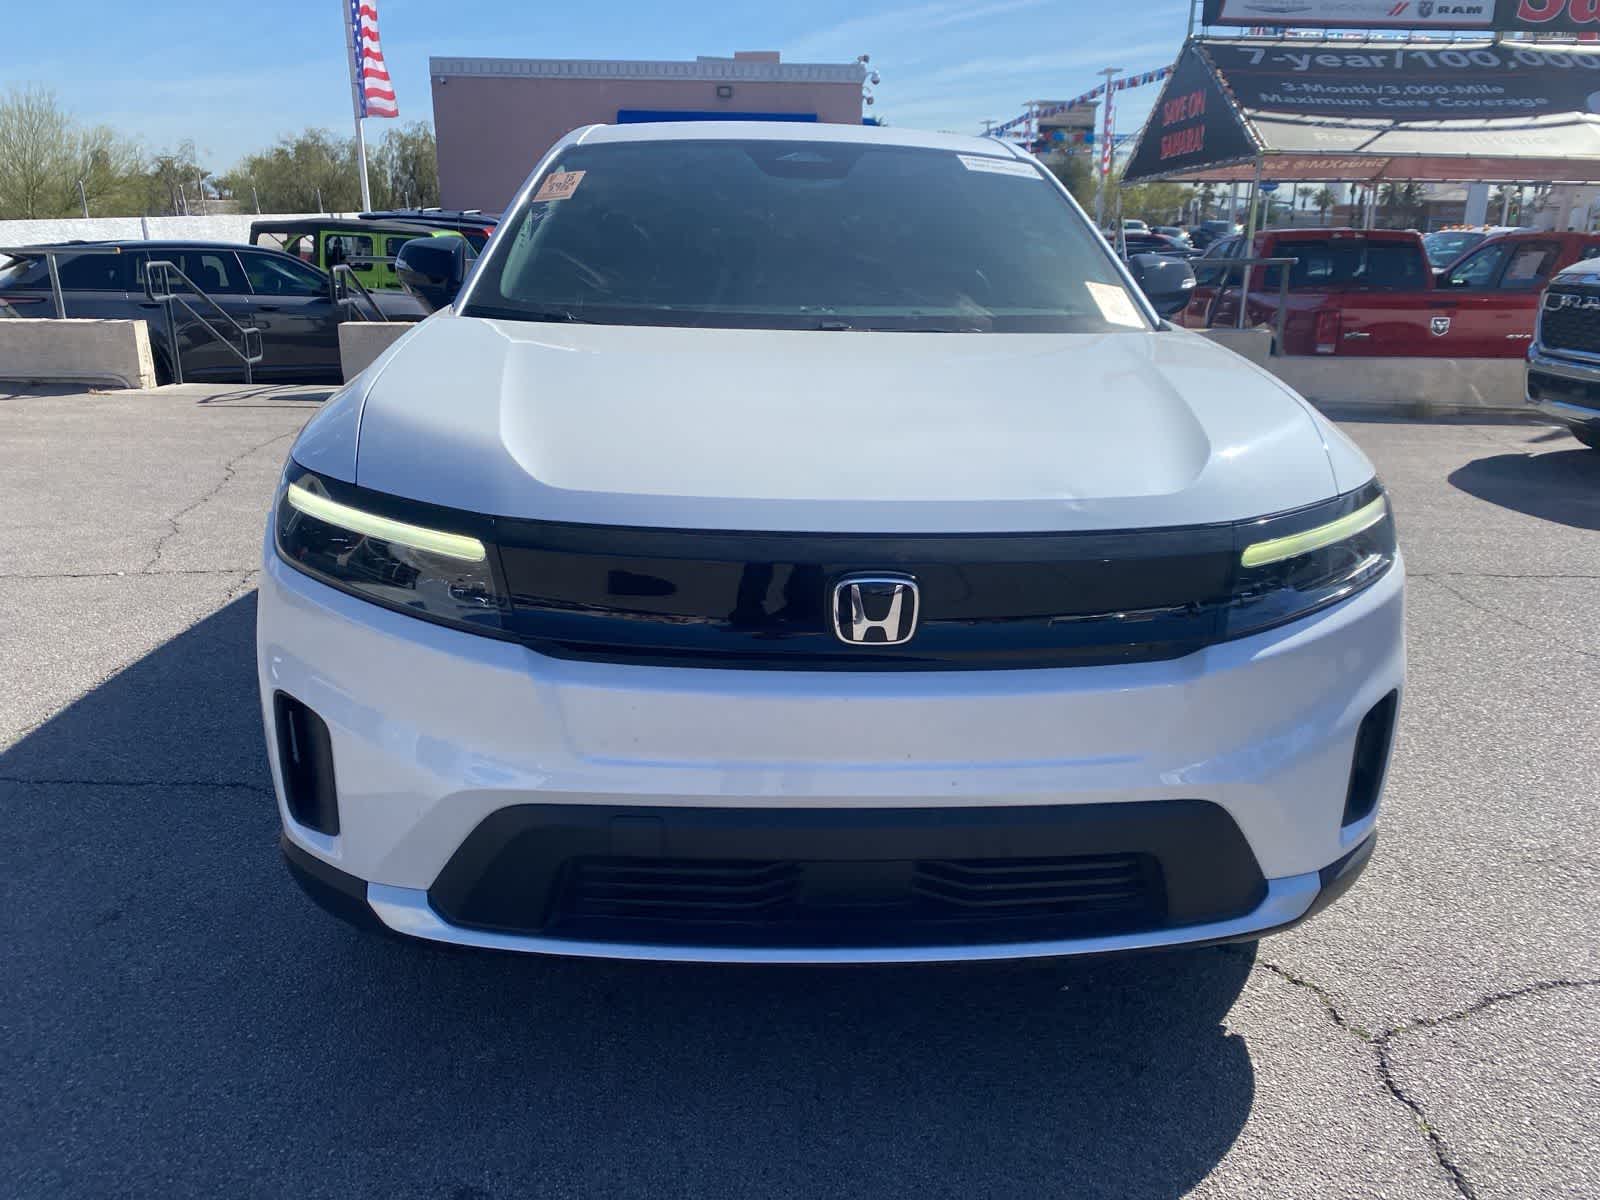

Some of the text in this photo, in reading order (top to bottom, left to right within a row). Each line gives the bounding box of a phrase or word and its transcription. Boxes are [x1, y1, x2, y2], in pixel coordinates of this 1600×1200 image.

[1438, 5, 1483, 14] RAM
[1163, 90, 1206, 126] SAVE ON
[1260, 93, 1549, 108] Maximum Care Coverage
